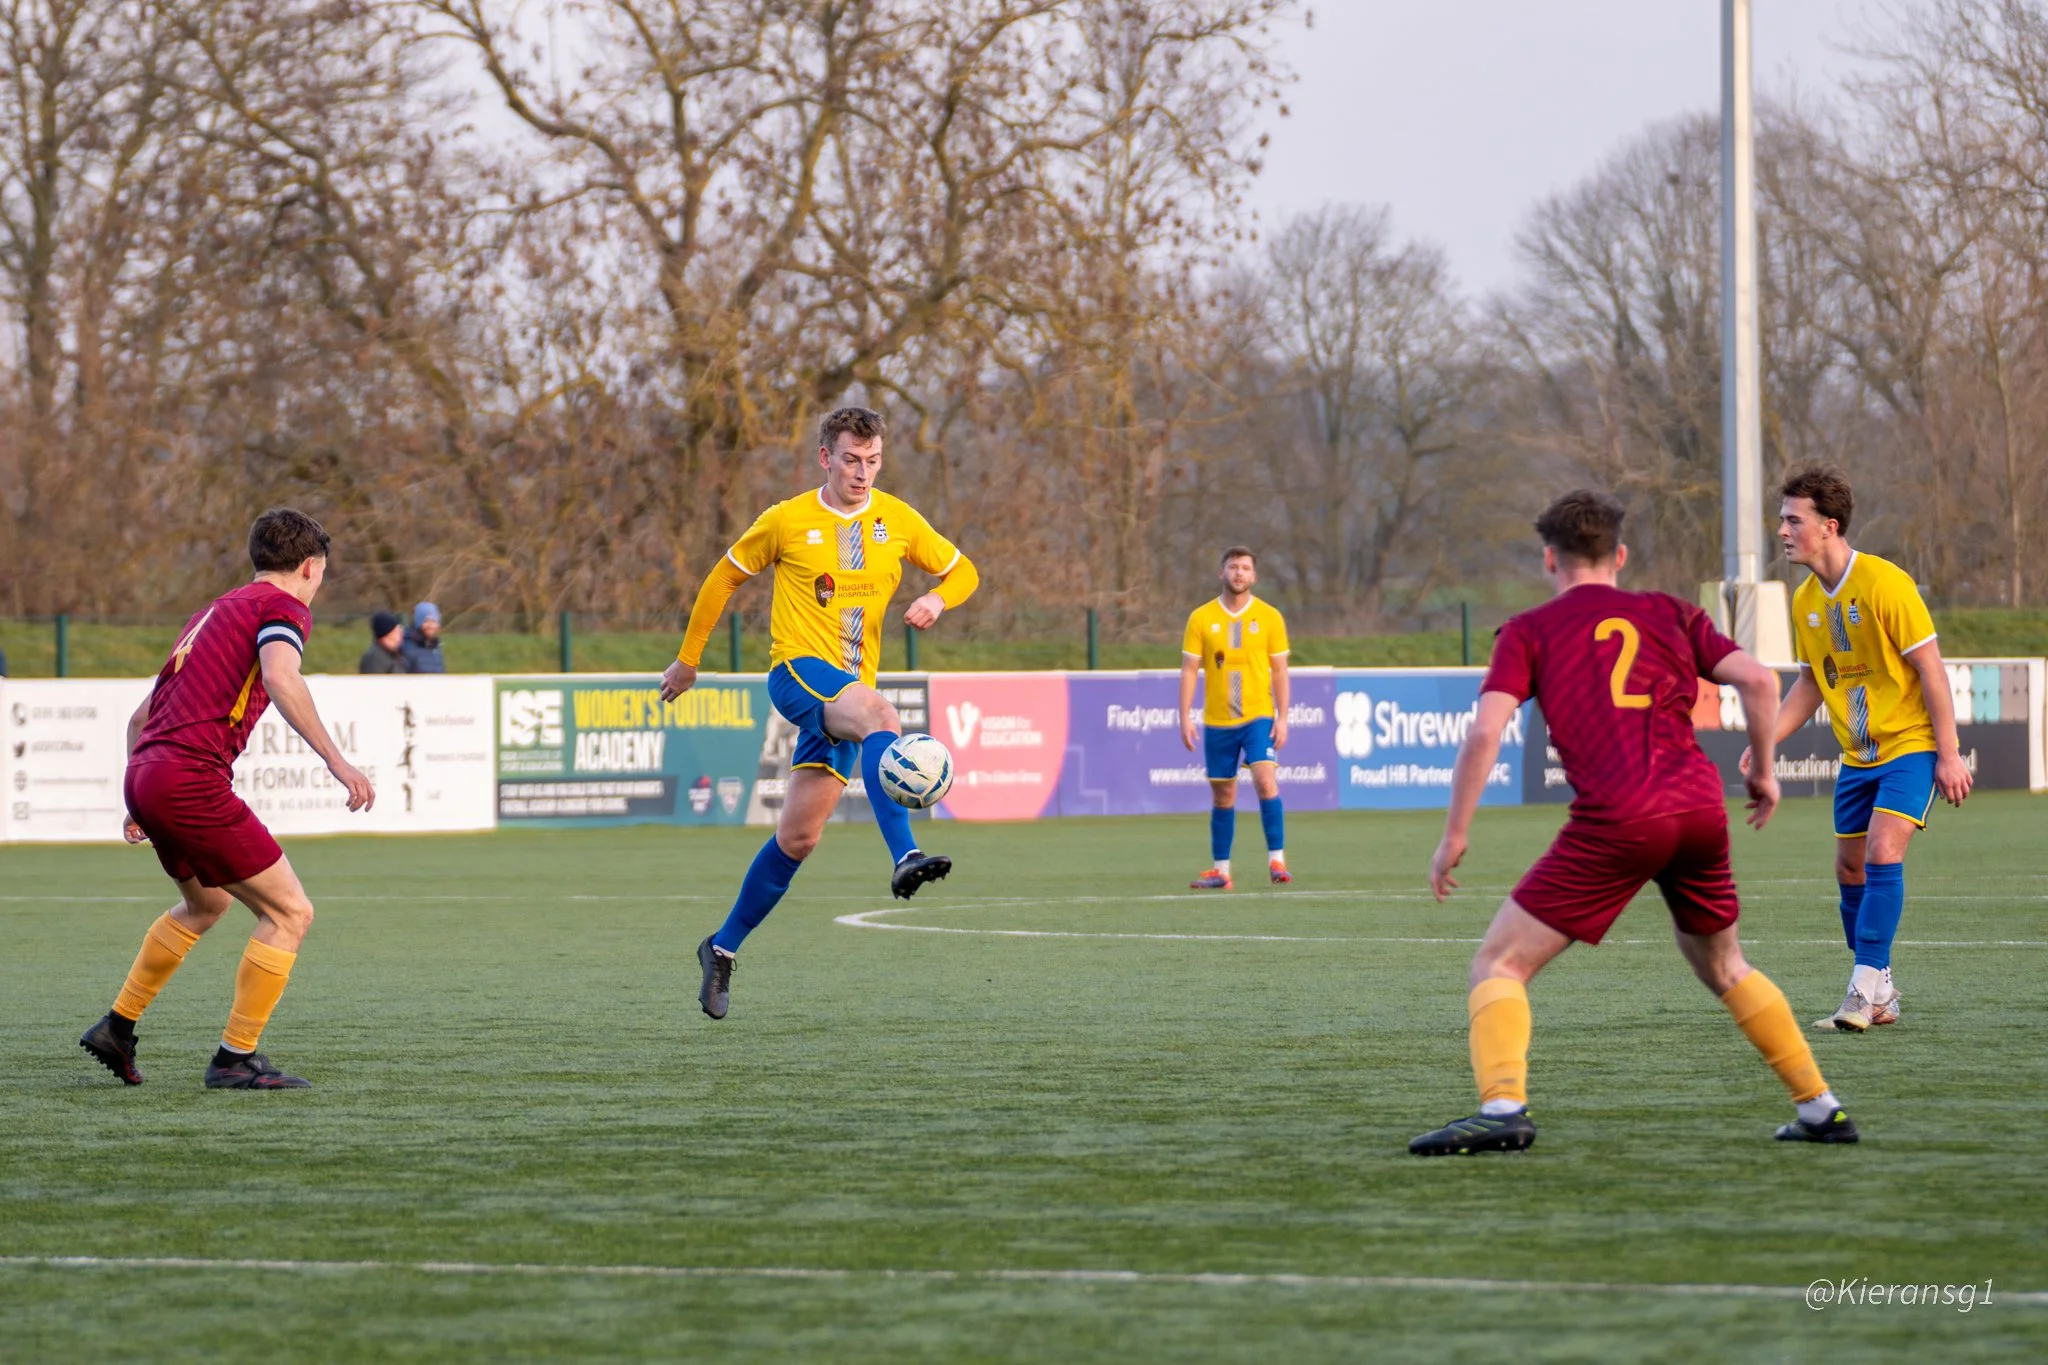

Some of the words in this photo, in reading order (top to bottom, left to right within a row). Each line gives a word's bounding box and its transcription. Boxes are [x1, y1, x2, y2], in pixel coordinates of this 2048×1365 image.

[837, 583, 875, 592] HUGHES
[837, 590, 879, 598] HOSPITALITY
[172, 606, 215, 674] 4
[1594, 617, 1653, 708] 2
[1838, 663, 1868, 673] HUGHES
[573, 688, 662, 729] WOMEN'S
[663, 688, 756, 729] FOOTBALL
[1107, 704, 1140, 731] Find
[1140, 708, 1176, 734] your
[1375, 700, 1479, 748] Shrewd
[573, 730, 666, 773] ACADEMY
[980, 731, 1043, 747] EDUCATION
[253, 766, 306, 791] FORM
[1350, 764, 1387, 788] Proud
[1388, 764, 1408, 787] HR
